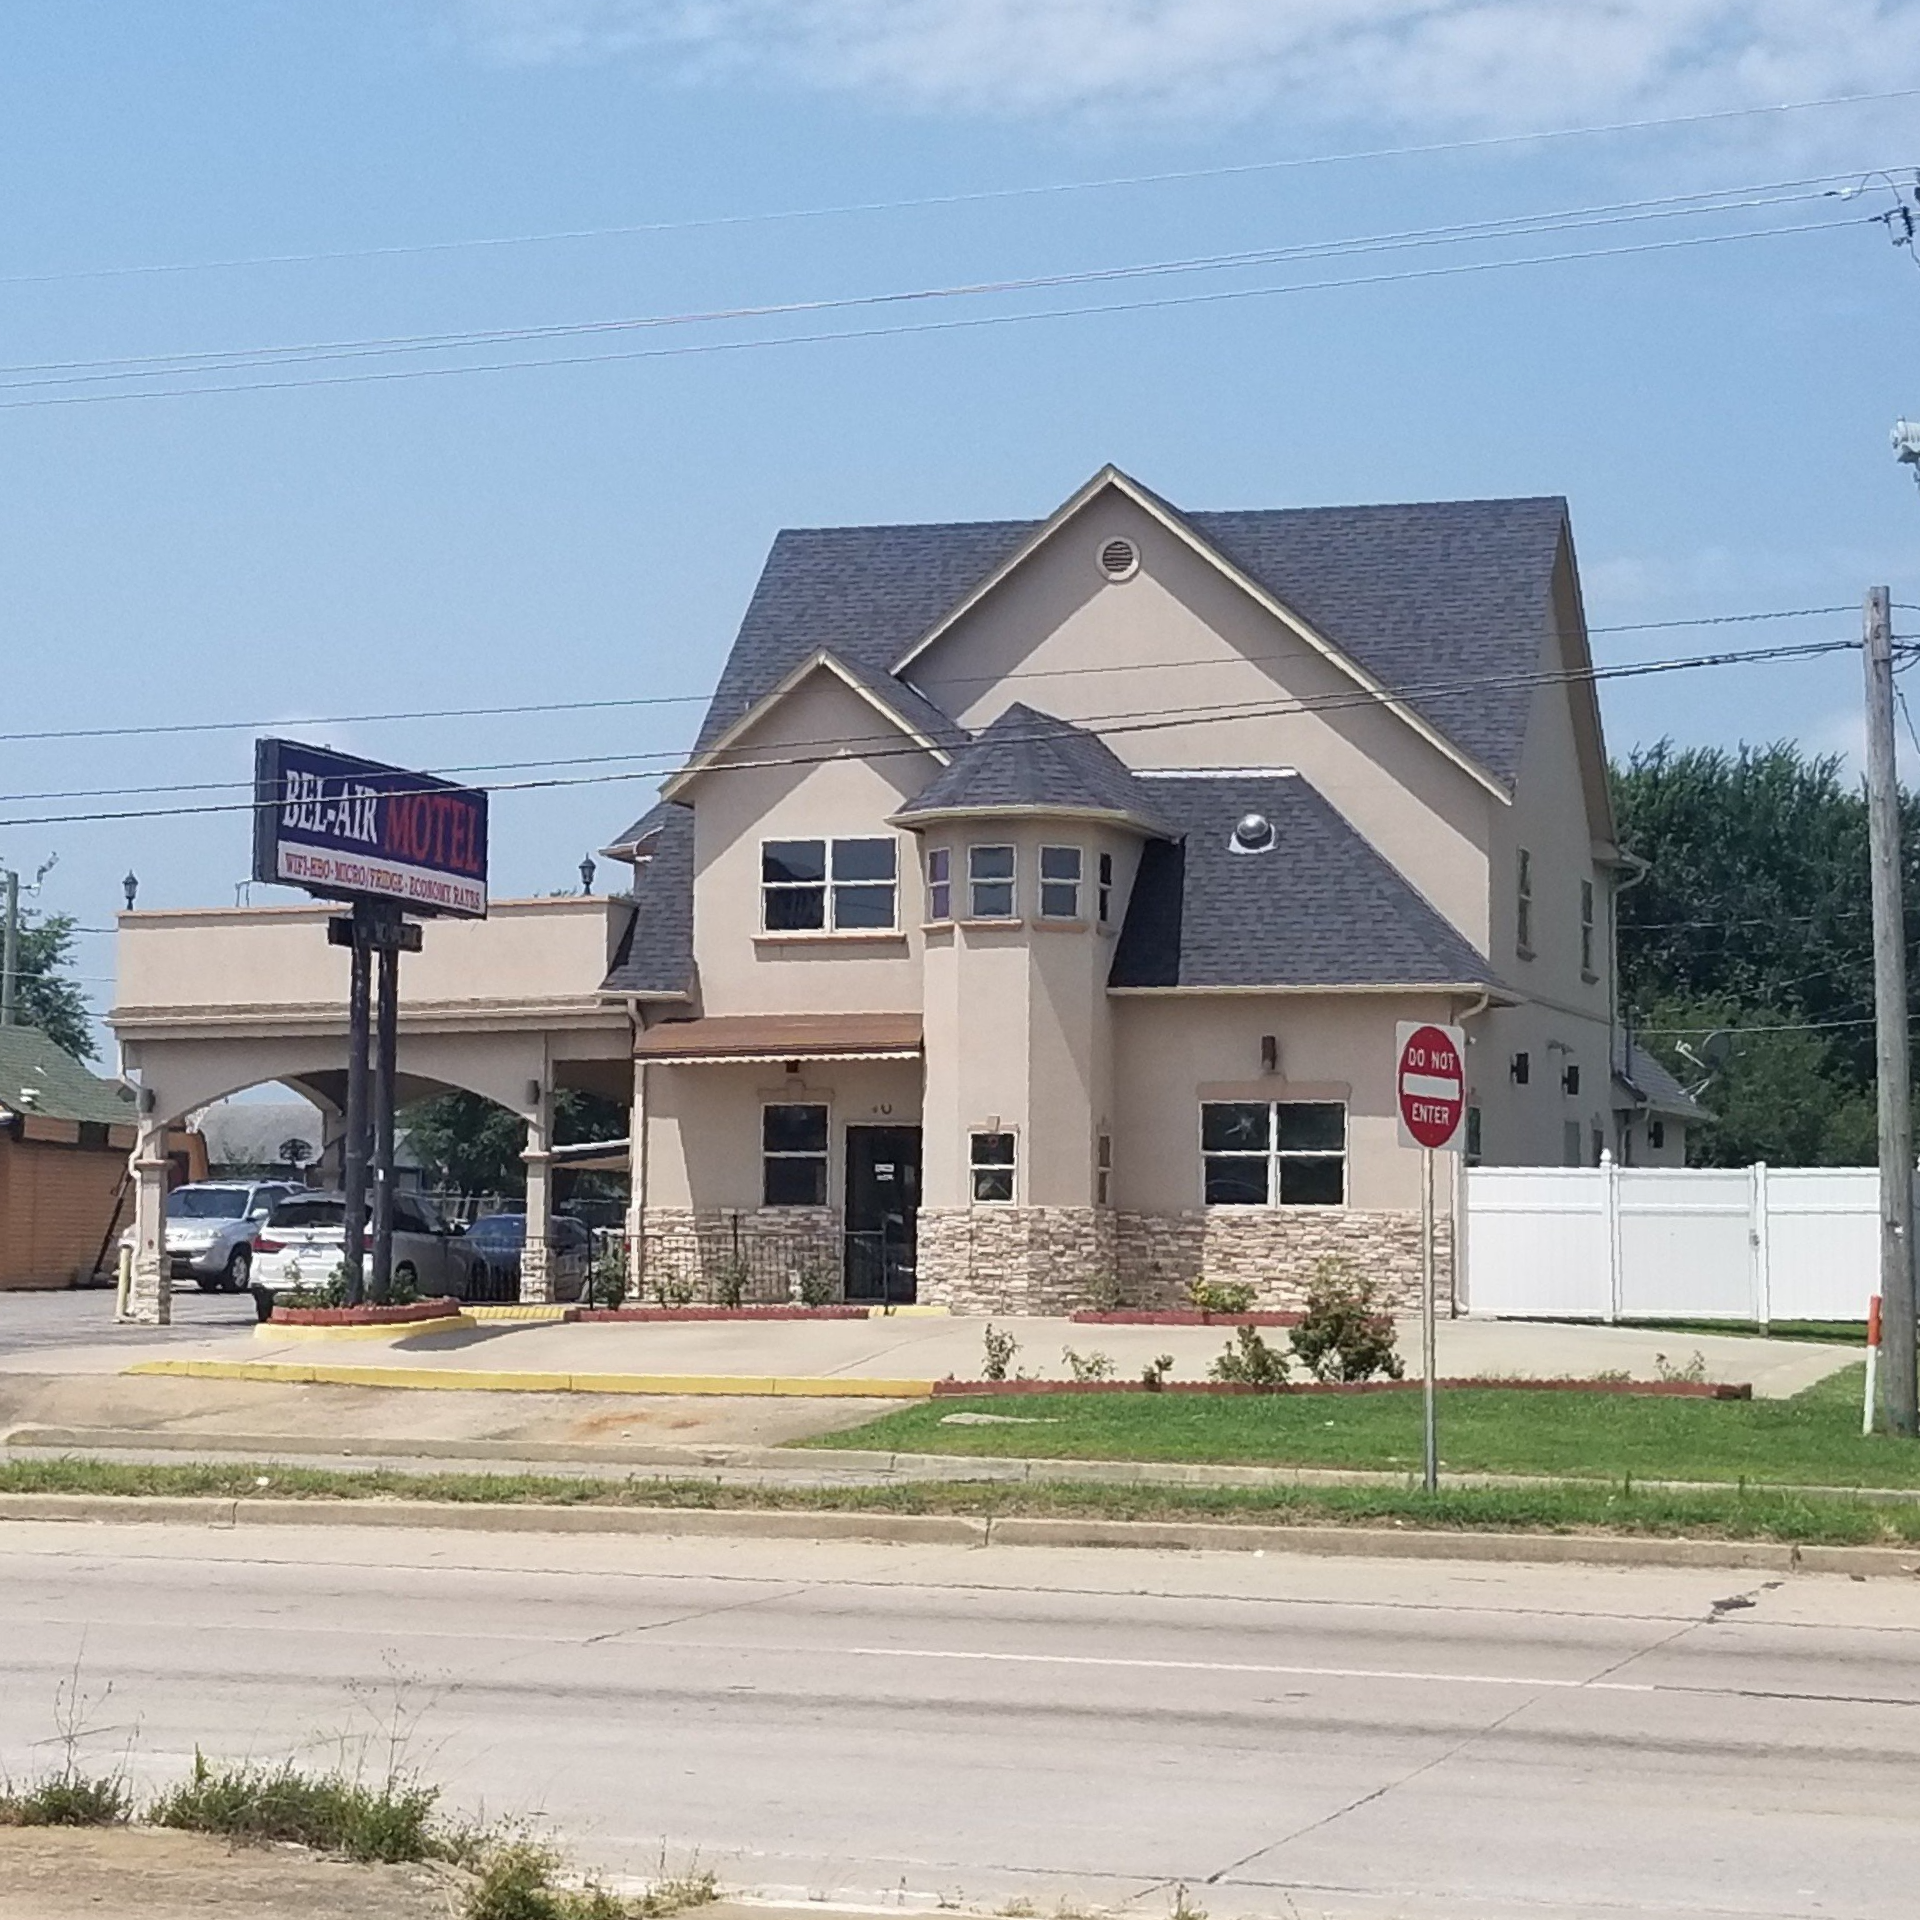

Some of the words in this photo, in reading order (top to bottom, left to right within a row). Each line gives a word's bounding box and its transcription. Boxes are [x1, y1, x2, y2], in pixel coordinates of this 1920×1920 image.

[282, 769, 378, 844] BEL-AIR
[384, 786, 479, 873] MOTEL
[409, 876, 452, 903] ECONOMY
[453, 884, 480, 910] RATES
[1408, 1047, 1425, 1066] DO
[1431, 1051, 1454, 1071] NOT
[1412, 1102, 1449, 1126] ENTER
